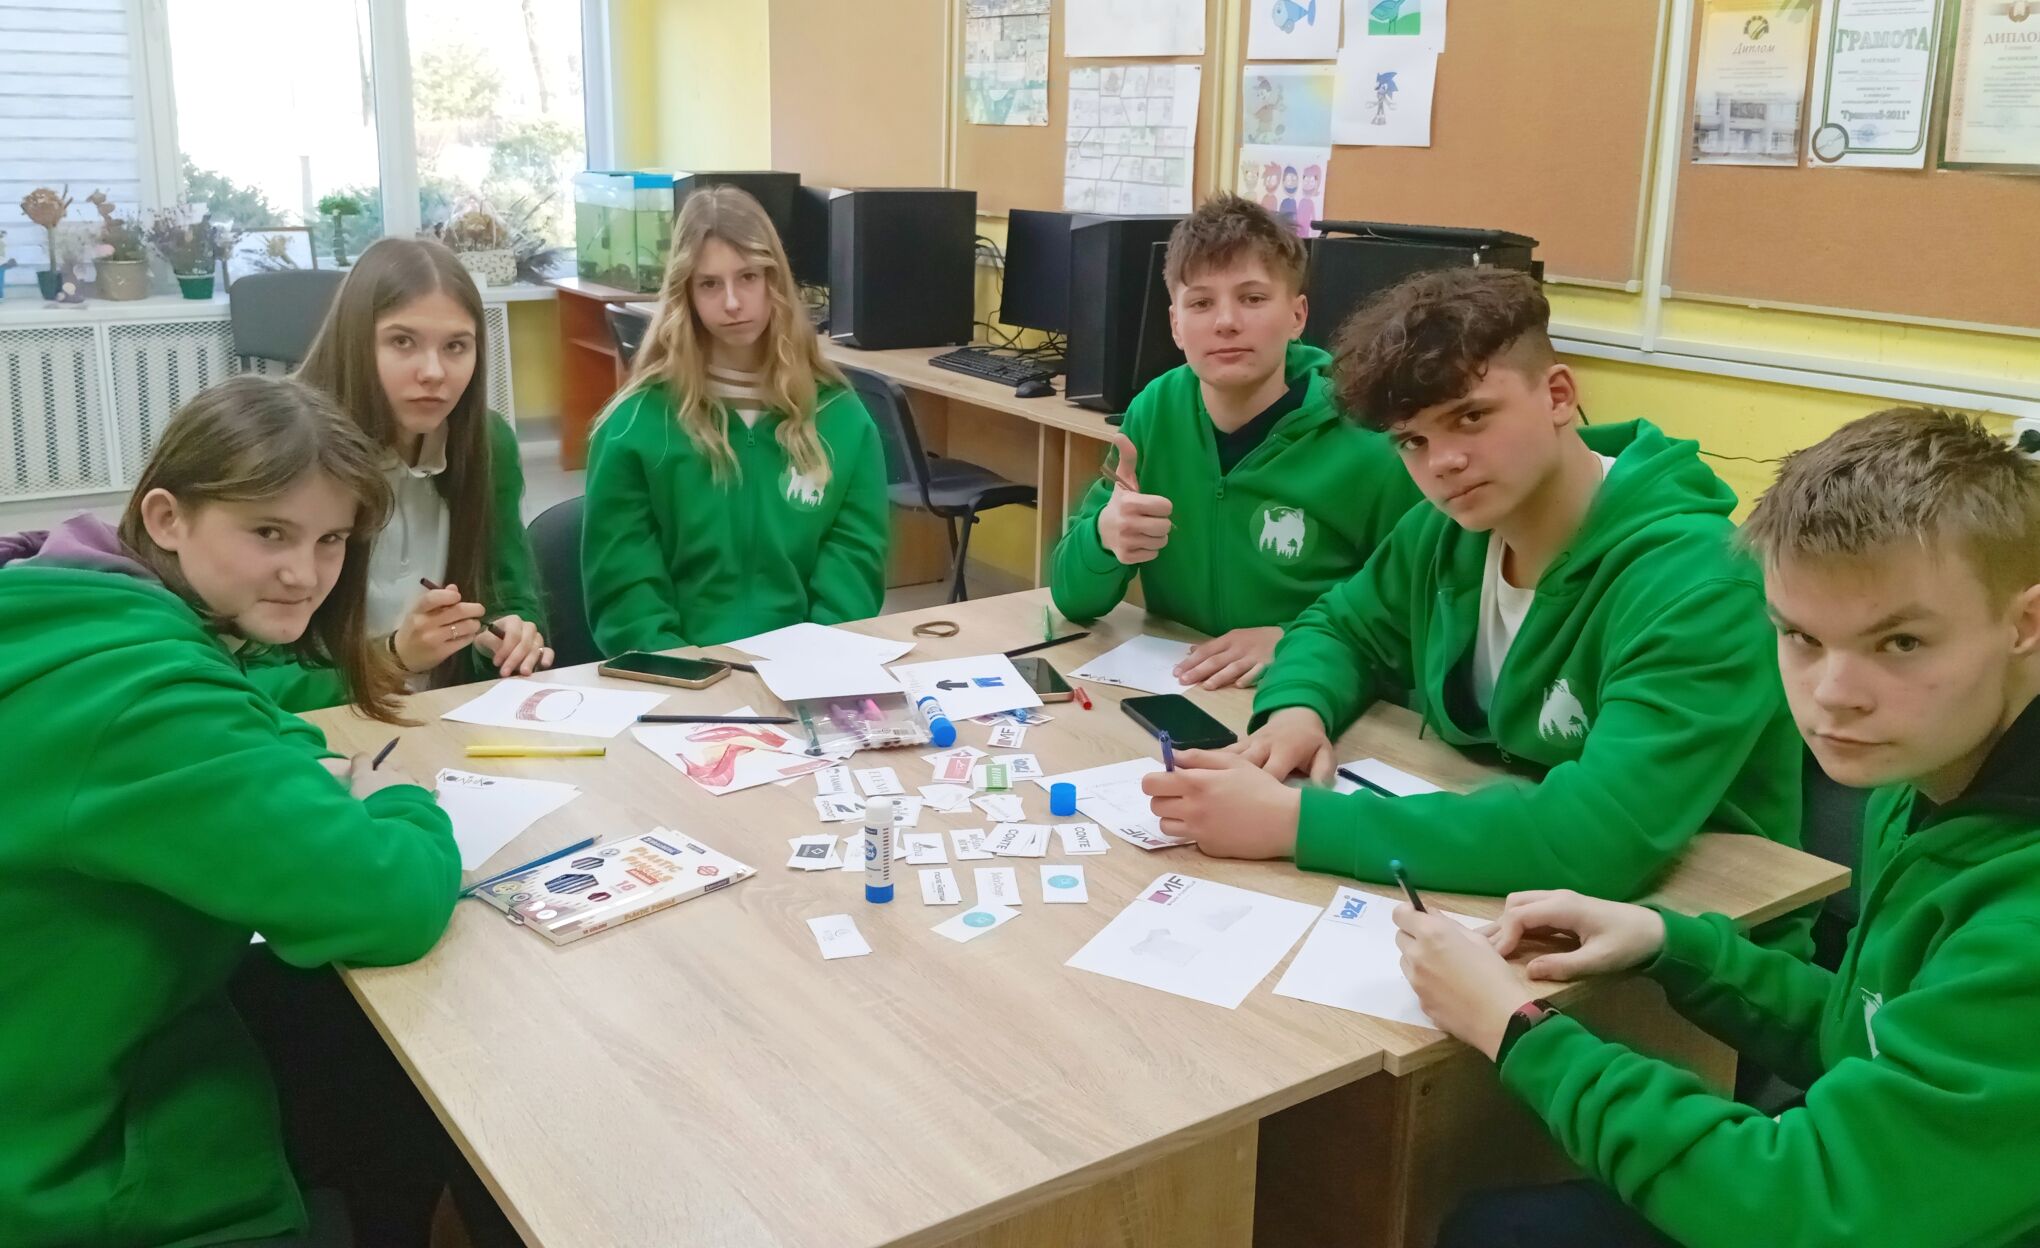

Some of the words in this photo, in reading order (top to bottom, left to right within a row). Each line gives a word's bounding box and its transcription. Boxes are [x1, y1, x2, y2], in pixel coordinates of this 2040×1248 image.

[1732, 43, 1775, 55] Диплом
[1836, 26, 1929, 53] ГРАМОТА
[1984, 31, 2040, 45] ДИПЛО
[996, 828, 1019, 850] CONTE
[1074, 826, 1091, 848] CONTE
[1157, 875, 1184, 898] MF
